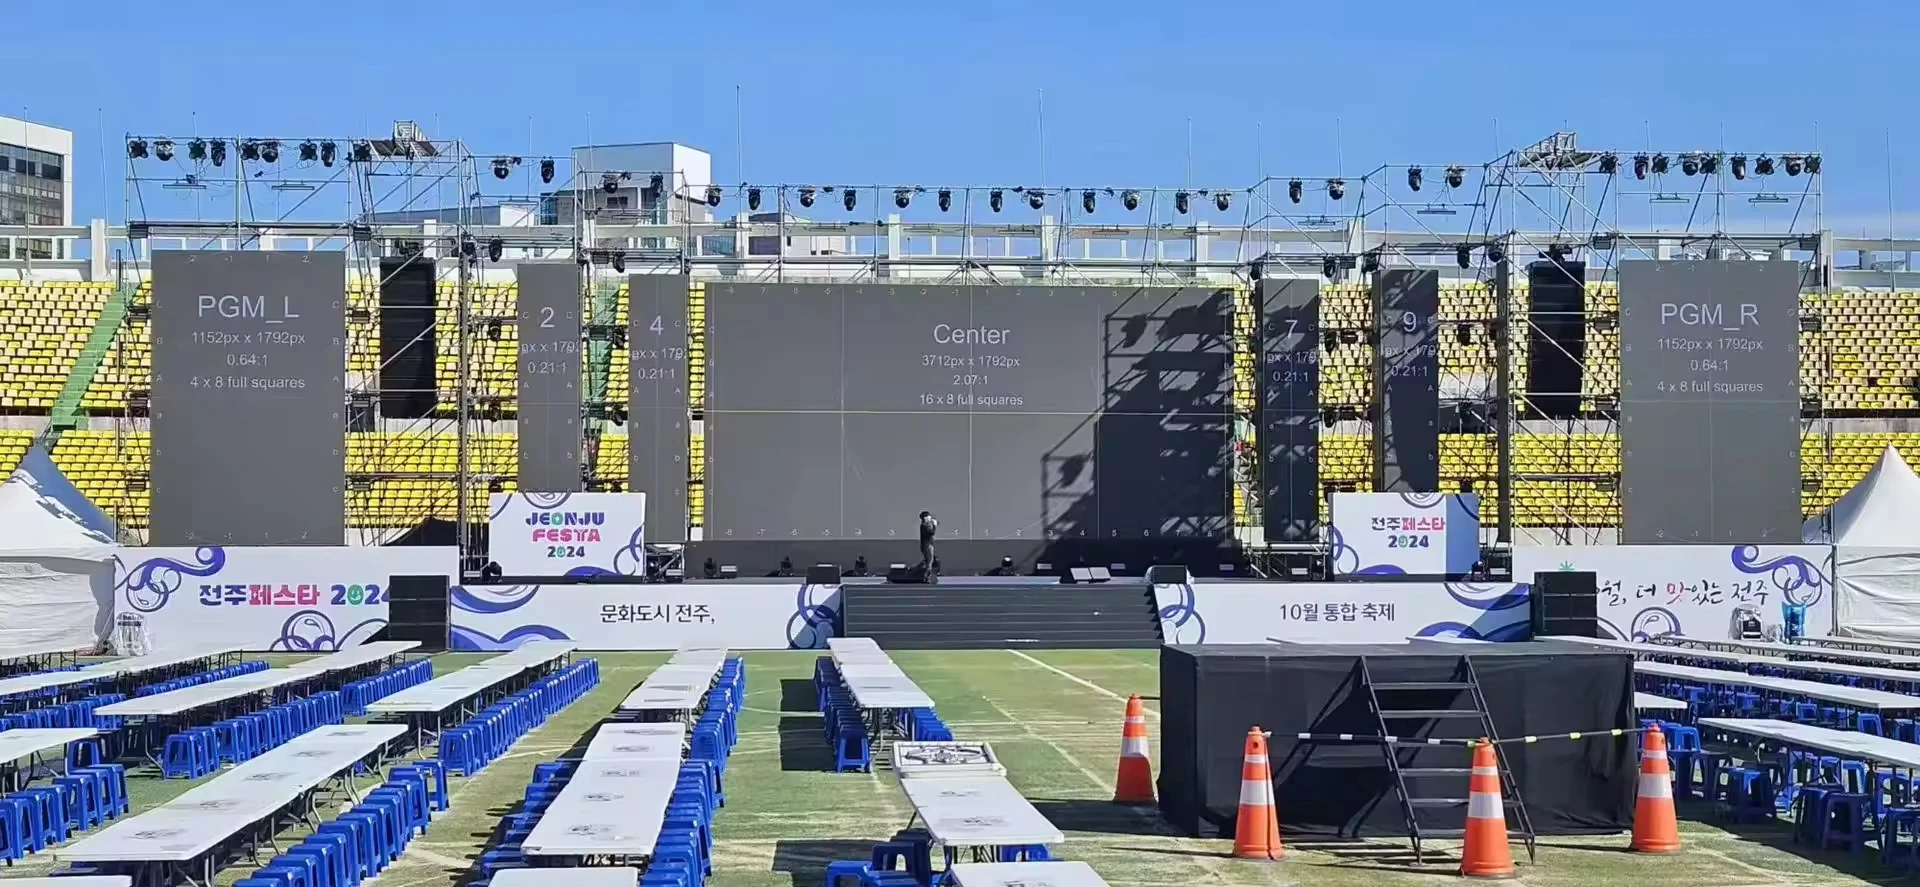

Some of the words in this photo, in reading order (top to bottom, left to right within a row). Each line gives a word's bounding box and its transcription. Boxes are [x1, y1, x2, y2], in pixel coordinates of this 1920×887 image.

[198, 295, 300, 324] PGM_L
[1660, 303, 1760, 331] PGM_R
[540, 306, 556, 329] 2
[1403, 311, 1417, 333] 9
[649, 315, 665, 336] 4
[1285, 319, 1298, 338] 7
[191, 331, 240, 346] 1152px
[243, 335, 251, 345] x
[257, 331, 306, 346] 1792px
[933, 323, 1011, 344] Center
[540, 343, 548, 353] x
[552, 340, 579, 354] 179
[1657, 338, 1703, 352] 1152px
[1705, 341, 1713, 350] x
[1717, 338, 1764, 352] 1792px
[226, 354, 269, 367] 0.64:1
[650, 349, 658, 359] x
[661, 347, 687, 361] 179
[921, 354, 965, 368] 3712px
[968, 358, 975, 367] x
[979, 355, 1021, 368] 1792px
[1284, 353, 1291, 362] x
[528, 361, 566, 374] 0.21:1
[638, 367, 675, 379] 0.21:1
[1391, 365, 1428, 377] 0.21:1
[1690, 359, 1729, 372] 0.64:1
[953, 374, 988, 385] 2.07:1
[1272, 370, 1309, 382] 0.21:1
[190, 376, 199, 389] 4
[203, 379, 212, 389] x
[215, 376, 223, 389] 8
[228, 376, 248, 389] full
[251, 378, 306, 392] squares
[1656, 381, 1665, 393] 4
[1669, 384, 1677, 393] x
[1680, 381, 1688, 393] 8
[1691, 380, 1710, 393] full
[1713, 383, 1764, 395] squares
[920, 393, 934, 405] 16
[936, 396, 944, 405] x
[946, 393, 954, 405] 8
[957, 393, 974, 406] full
[977, 396, 1024, 408] squares
[525, 511, 605, 526] JEONJU
[1371, 516, 1446, 531] 전주페스타
[532, 528, 601, 542] FESTA
[1388, 535, 1429, 548] 2024
[547, 546, 585, 558] 2024
[199, 584, 320, 606] 전주페스타
[1596, 579, 1627, 606] 월,
[1636, 583, 1656, 598] 더
[1666, 579, 1724, 605] 맛있는
[1731, 579, 1769, 605] 전주
[600, 604, 670, 624] 문화도시
[675, 604, 715, 625] 전주,
[1280, 603, 1319, 622] 10월
[1323, 603, 1357, 622] 통합
[1361, 602, 1395, 622] 축제
